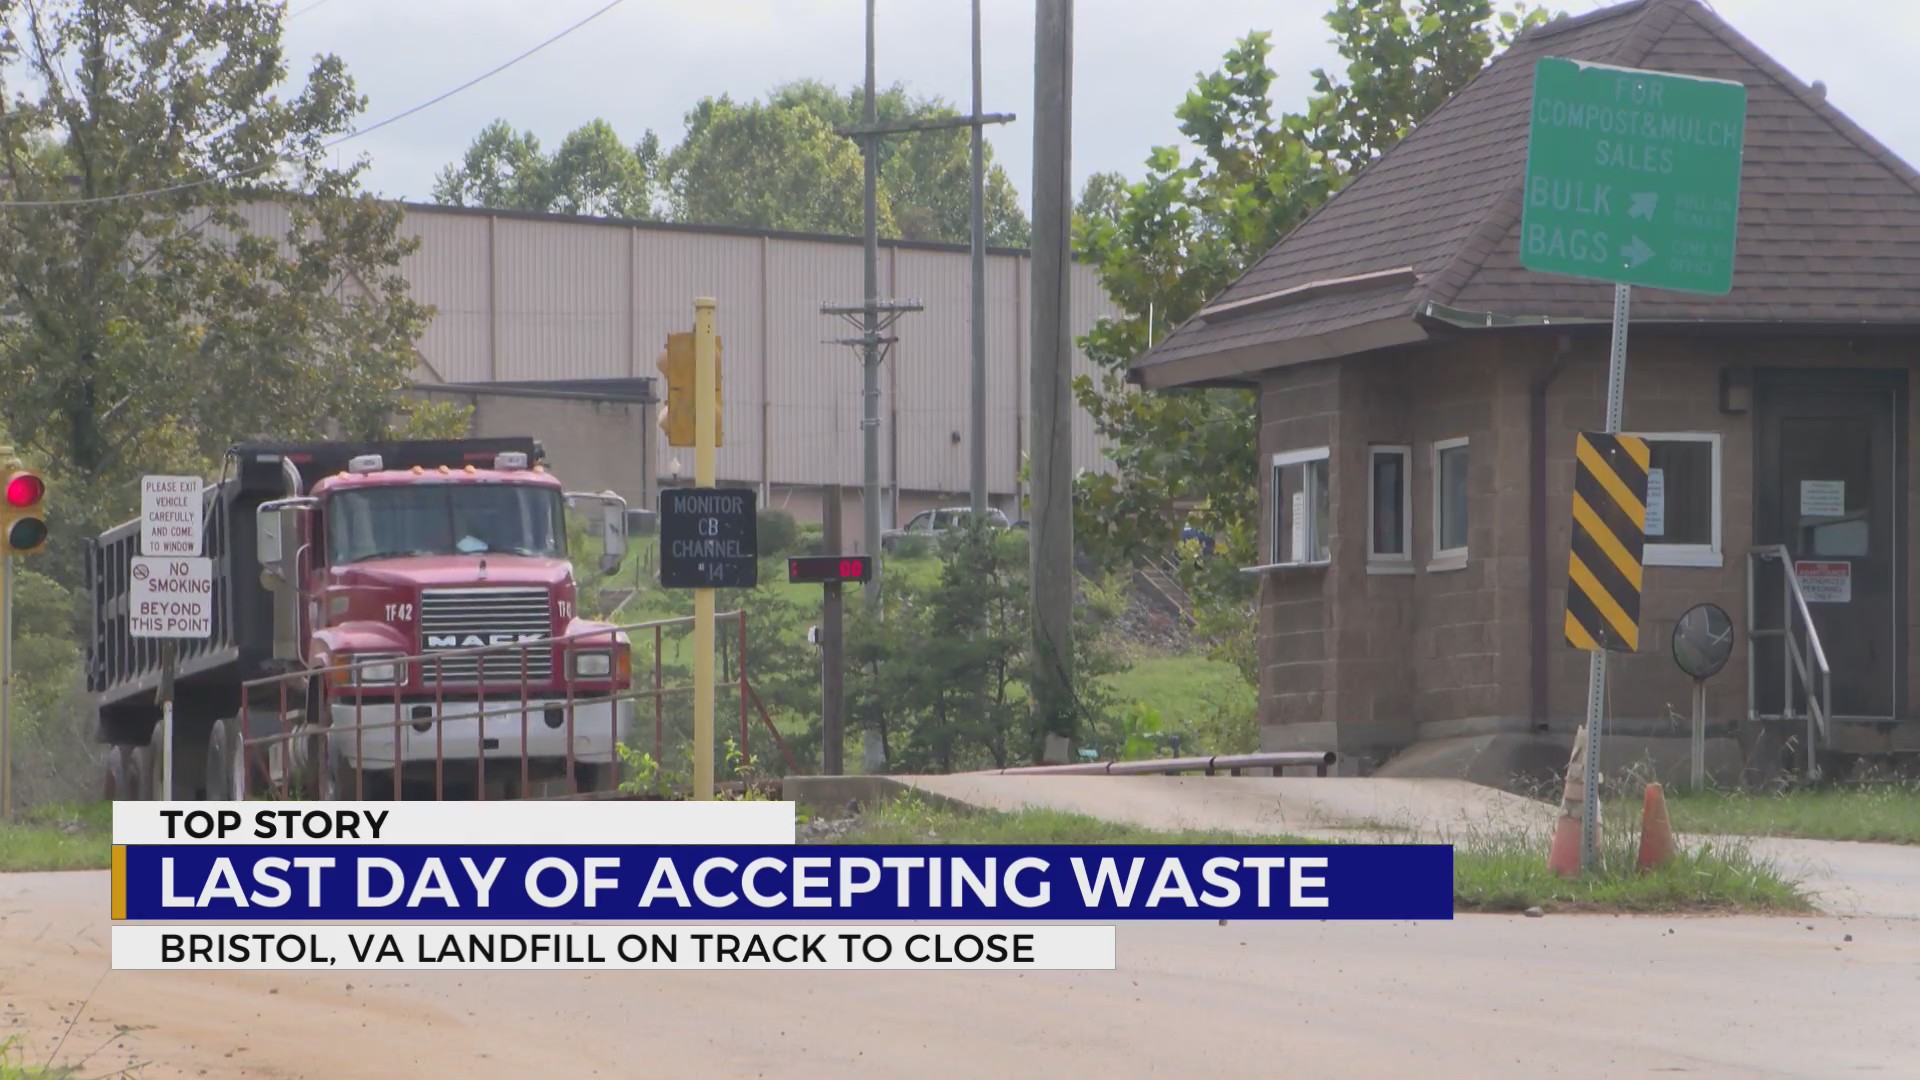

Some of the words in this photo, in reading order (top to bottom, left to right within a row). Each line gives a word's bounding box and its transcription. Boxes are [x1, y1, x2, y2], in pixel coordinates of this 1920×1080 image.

[1615, 76, 1664, 108] FOR
[1595, 139, 1674, 174] SALES
[1530, 175, 1613, 217] BULK
[1527, 223, 1609, 264] BAGS
[146, 481, 177, 492] PLEASE
[180, 481, 197, 492] EXIT
[156, 496, 188, 507] VEHICLE
[674, 496, 742, 514] MONITOR
[149, 511, 194, 522] CAREFULLY
[151, 526, 168, 537] AND
[171, 526, 192, 537] COME
[698, 517, 718, 536] CB
[150, 541, 160, 551] TO
[163, 541, 194, 551] WINDOW
[672, 540, 742, 558] CHANNEL
[169, 562, 189, 576] NO
[148, 578, 211, 593] SMOKING
[140, 601, 201, 616] BEYOND
[131, 617, 163, 631] THIS
[167, 618, 210, 632] POINT
[428, 634, 544, 648] MACK
